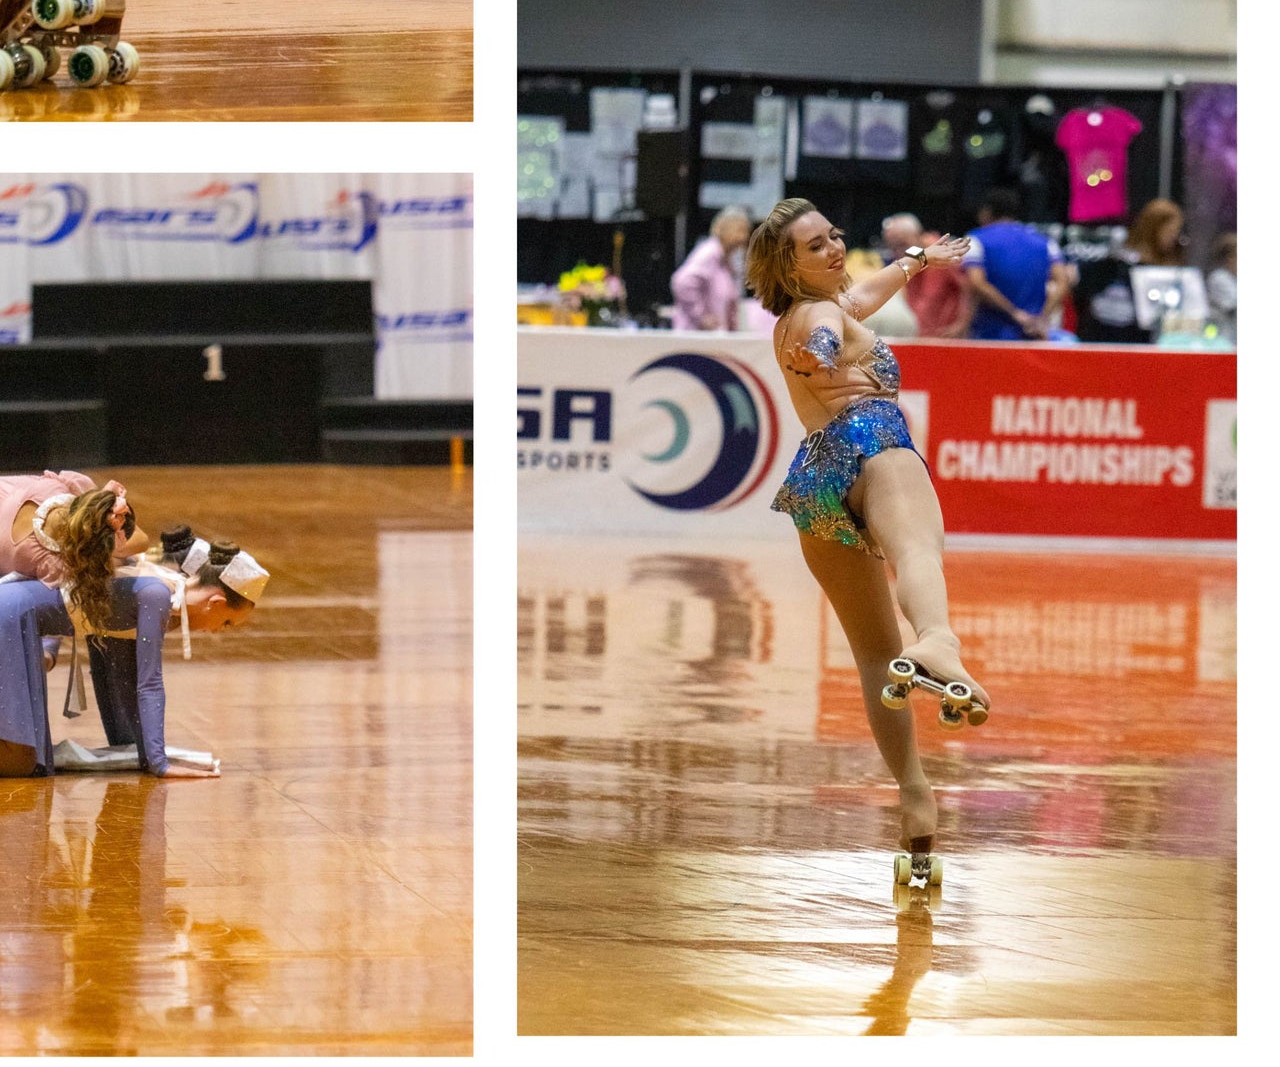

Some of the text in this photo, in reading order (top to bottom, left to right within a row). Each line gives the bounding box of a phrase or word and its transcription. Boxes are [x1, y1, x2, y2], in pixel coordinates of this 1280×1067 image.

[202, 344, 227, 381] 1
[517, 389, 611, 442] SA
[992, 395, 1144, 439] NATIONAL
[938, 439, 1194, 486] CHAMPIONSHIPS
